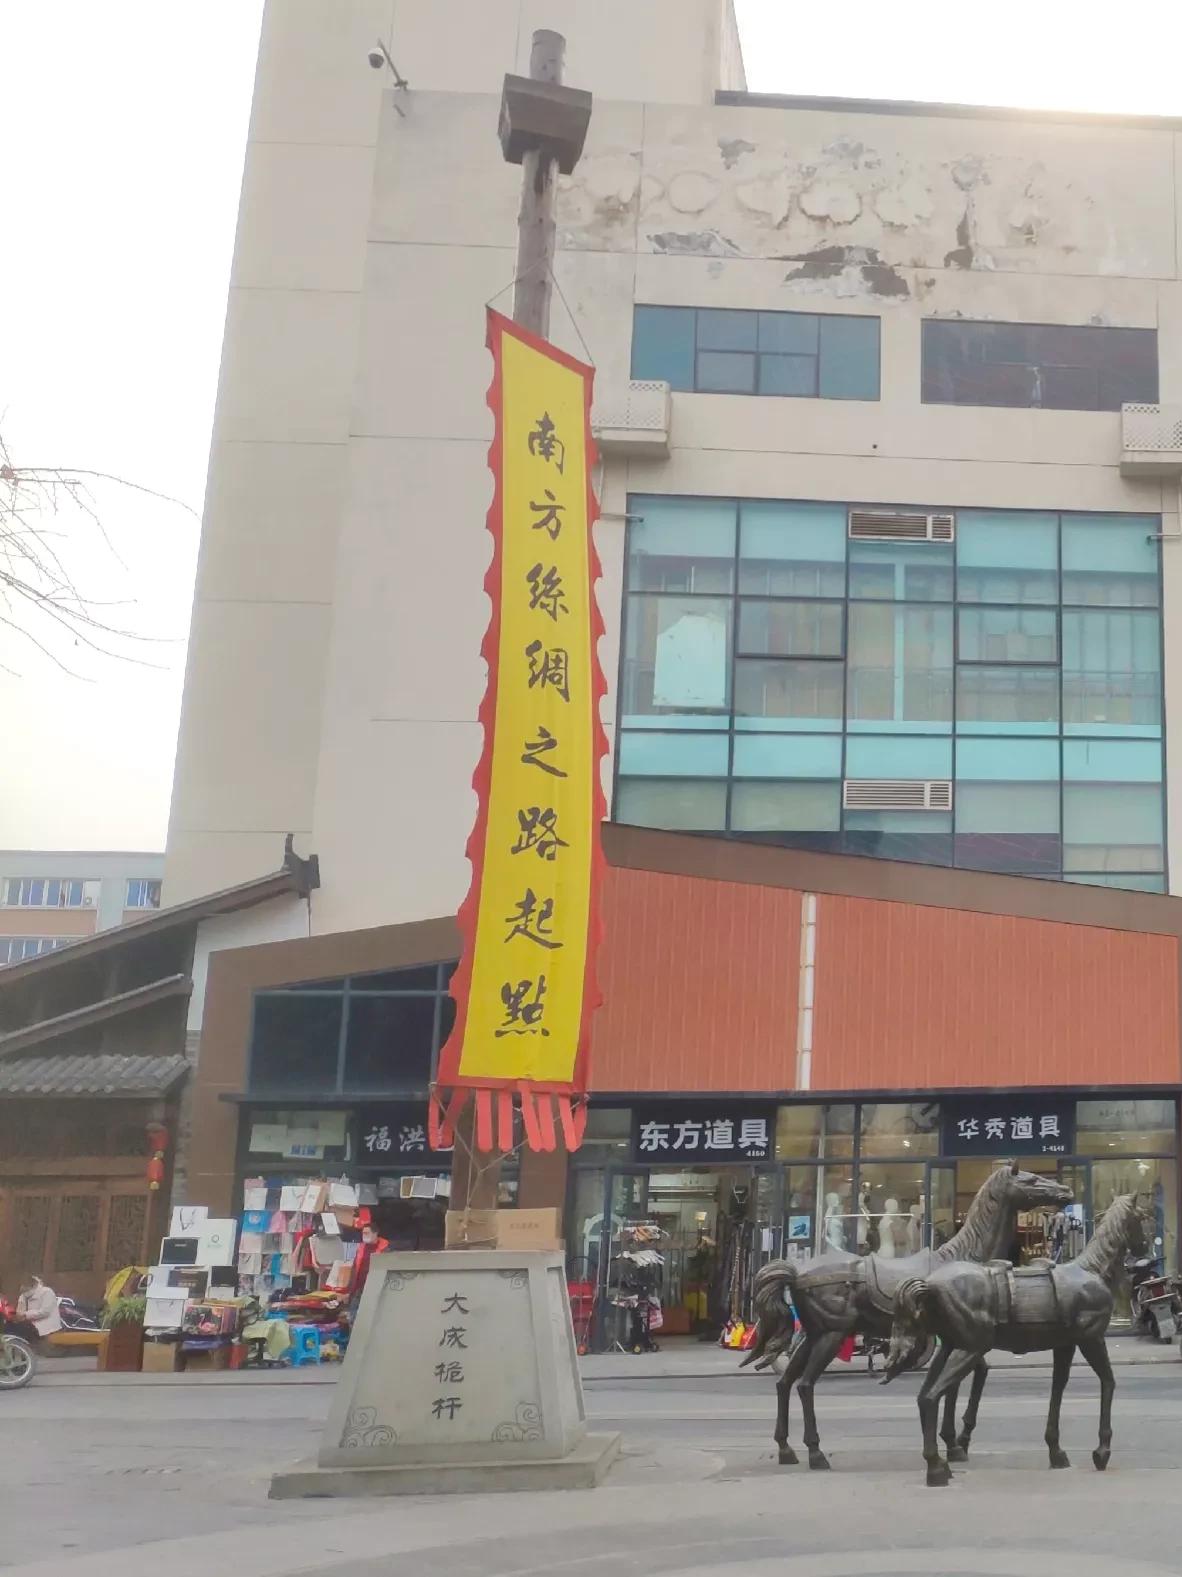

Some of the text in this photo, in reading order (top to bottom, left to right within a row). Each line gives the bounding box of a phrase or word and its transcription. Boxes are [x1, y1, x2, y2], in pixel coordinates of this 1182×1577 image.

[495, 411, 570, 1037] 南方絲綢之路起點
[364, 1125, 455, 1152] 福洪
[639, 1119, 769, 1151] 东方道具
[957, 1115, 1060, 1140] 华秀道具
[431, 1292, 470, 1420] 大成桅杆
